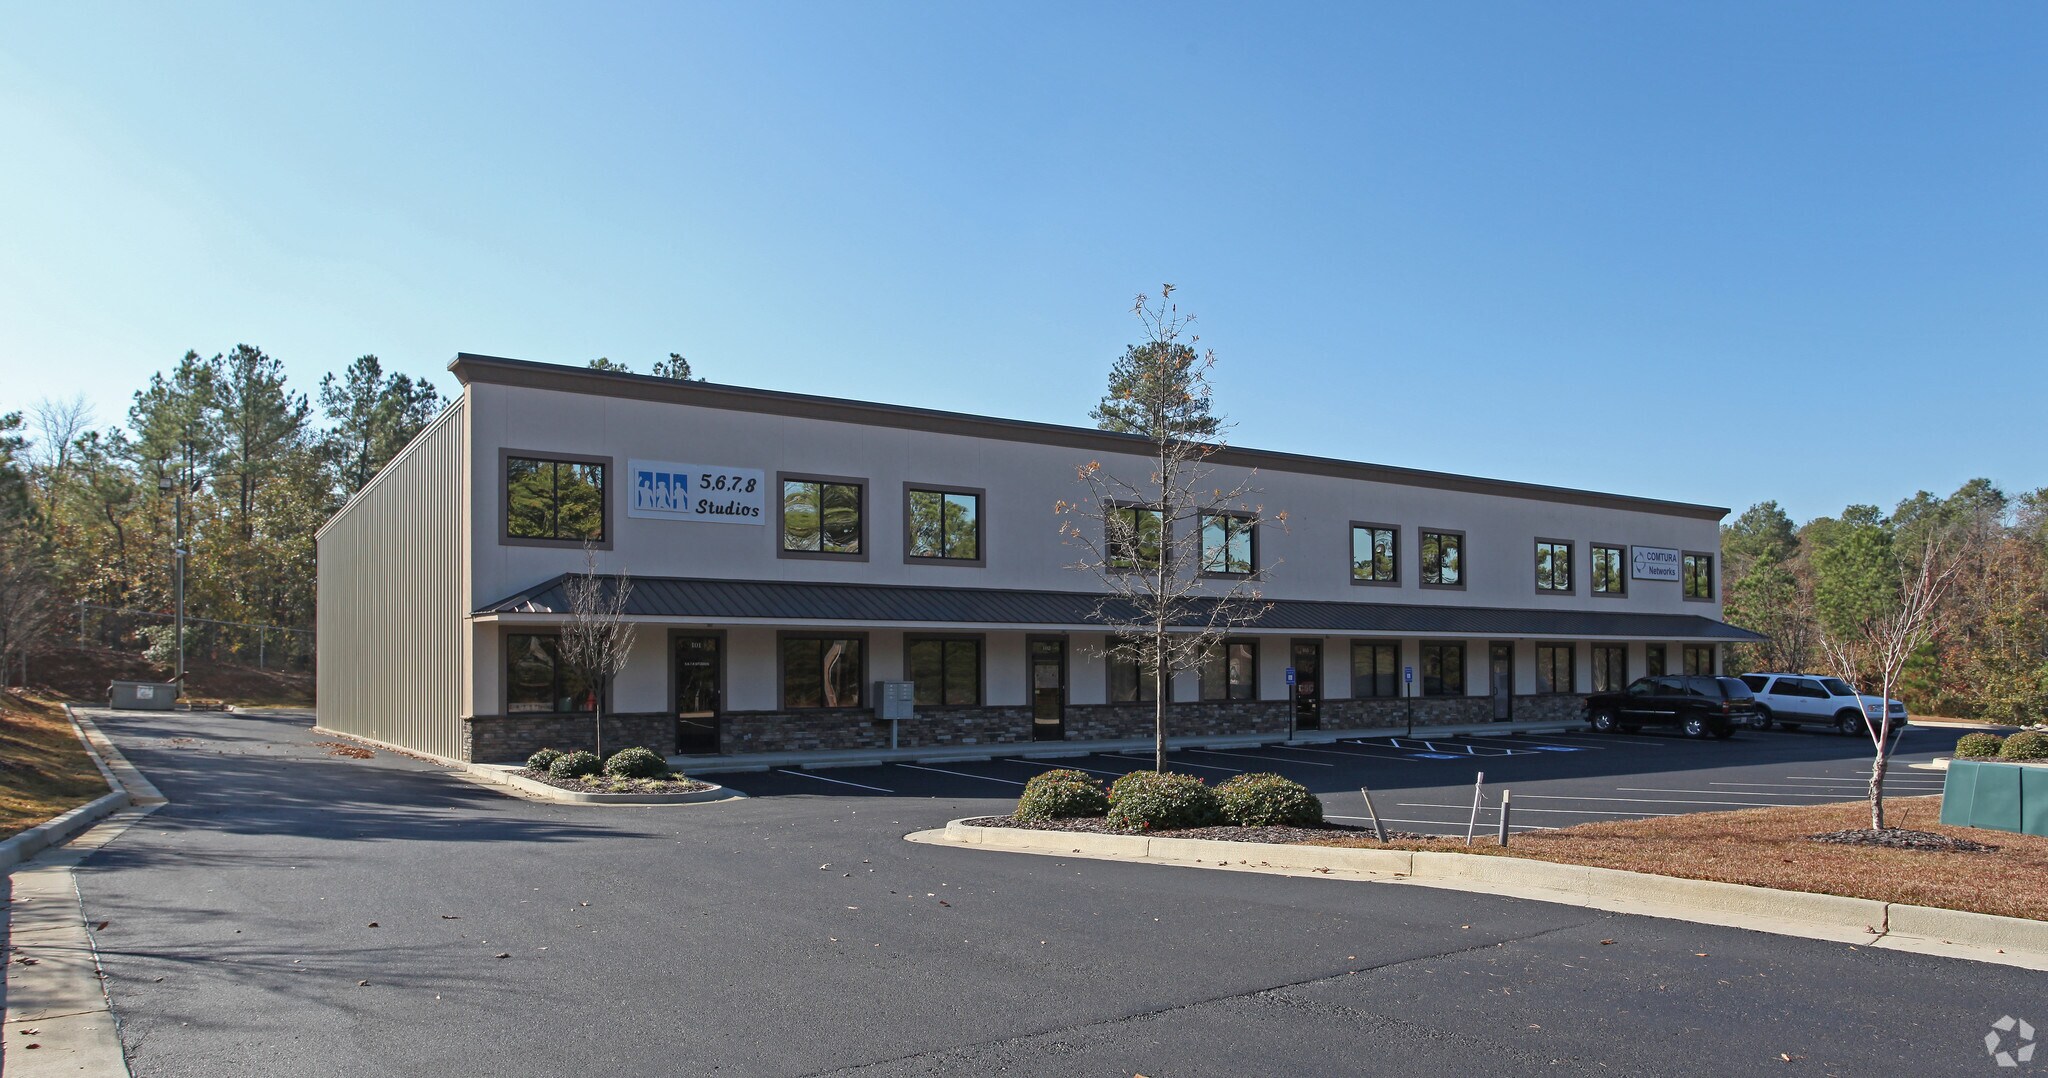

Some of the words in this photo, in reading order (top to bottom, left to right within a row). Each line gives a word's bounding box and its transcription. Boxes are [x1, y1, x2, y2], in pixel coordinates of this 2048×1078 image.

[695, 499, 759, 517] Studios
[1646, 552, 1677, 562] COMTURA
[1649, 566, 1675, 576] Networks
